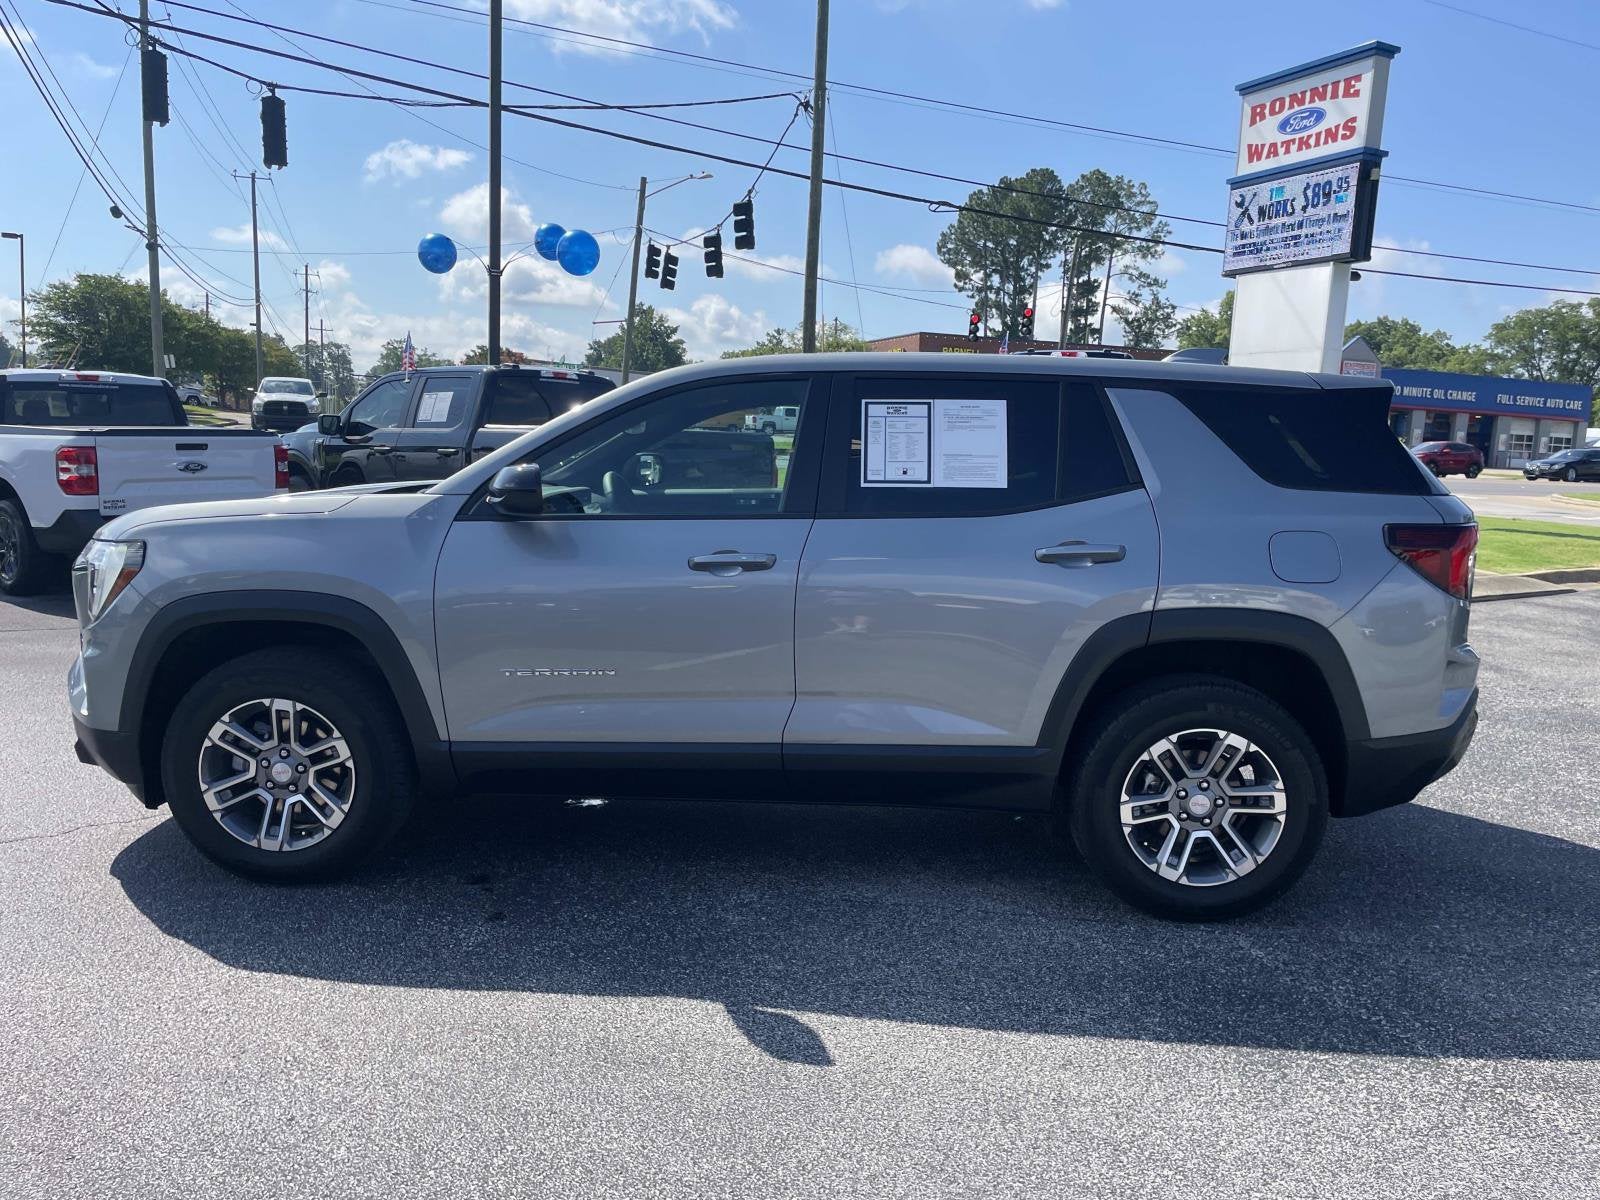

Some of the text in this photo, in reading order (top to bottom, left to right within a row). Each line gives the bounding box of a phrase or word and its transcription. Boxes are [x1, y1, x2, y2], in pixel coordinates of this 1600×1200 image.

[1249, 74, 1362, 127] RONNIE
[1287, 112, 1317, 132] Ford
[1246, 116, 1358, 164] WATKINS
[1301, 176, 1350, 214] $89.95
[1257, 197, 1296, 222] WORKS
[1402, 386, 1431, 398] MINUTE
[1433, 388, 1445, 400] OIL
[1447, 390, 1476, 402] CHANGE
[1496, 394, 1583, 411] FULL SERVICE AUTO CARE
[500, 667, 616, 677] TERRAIN
